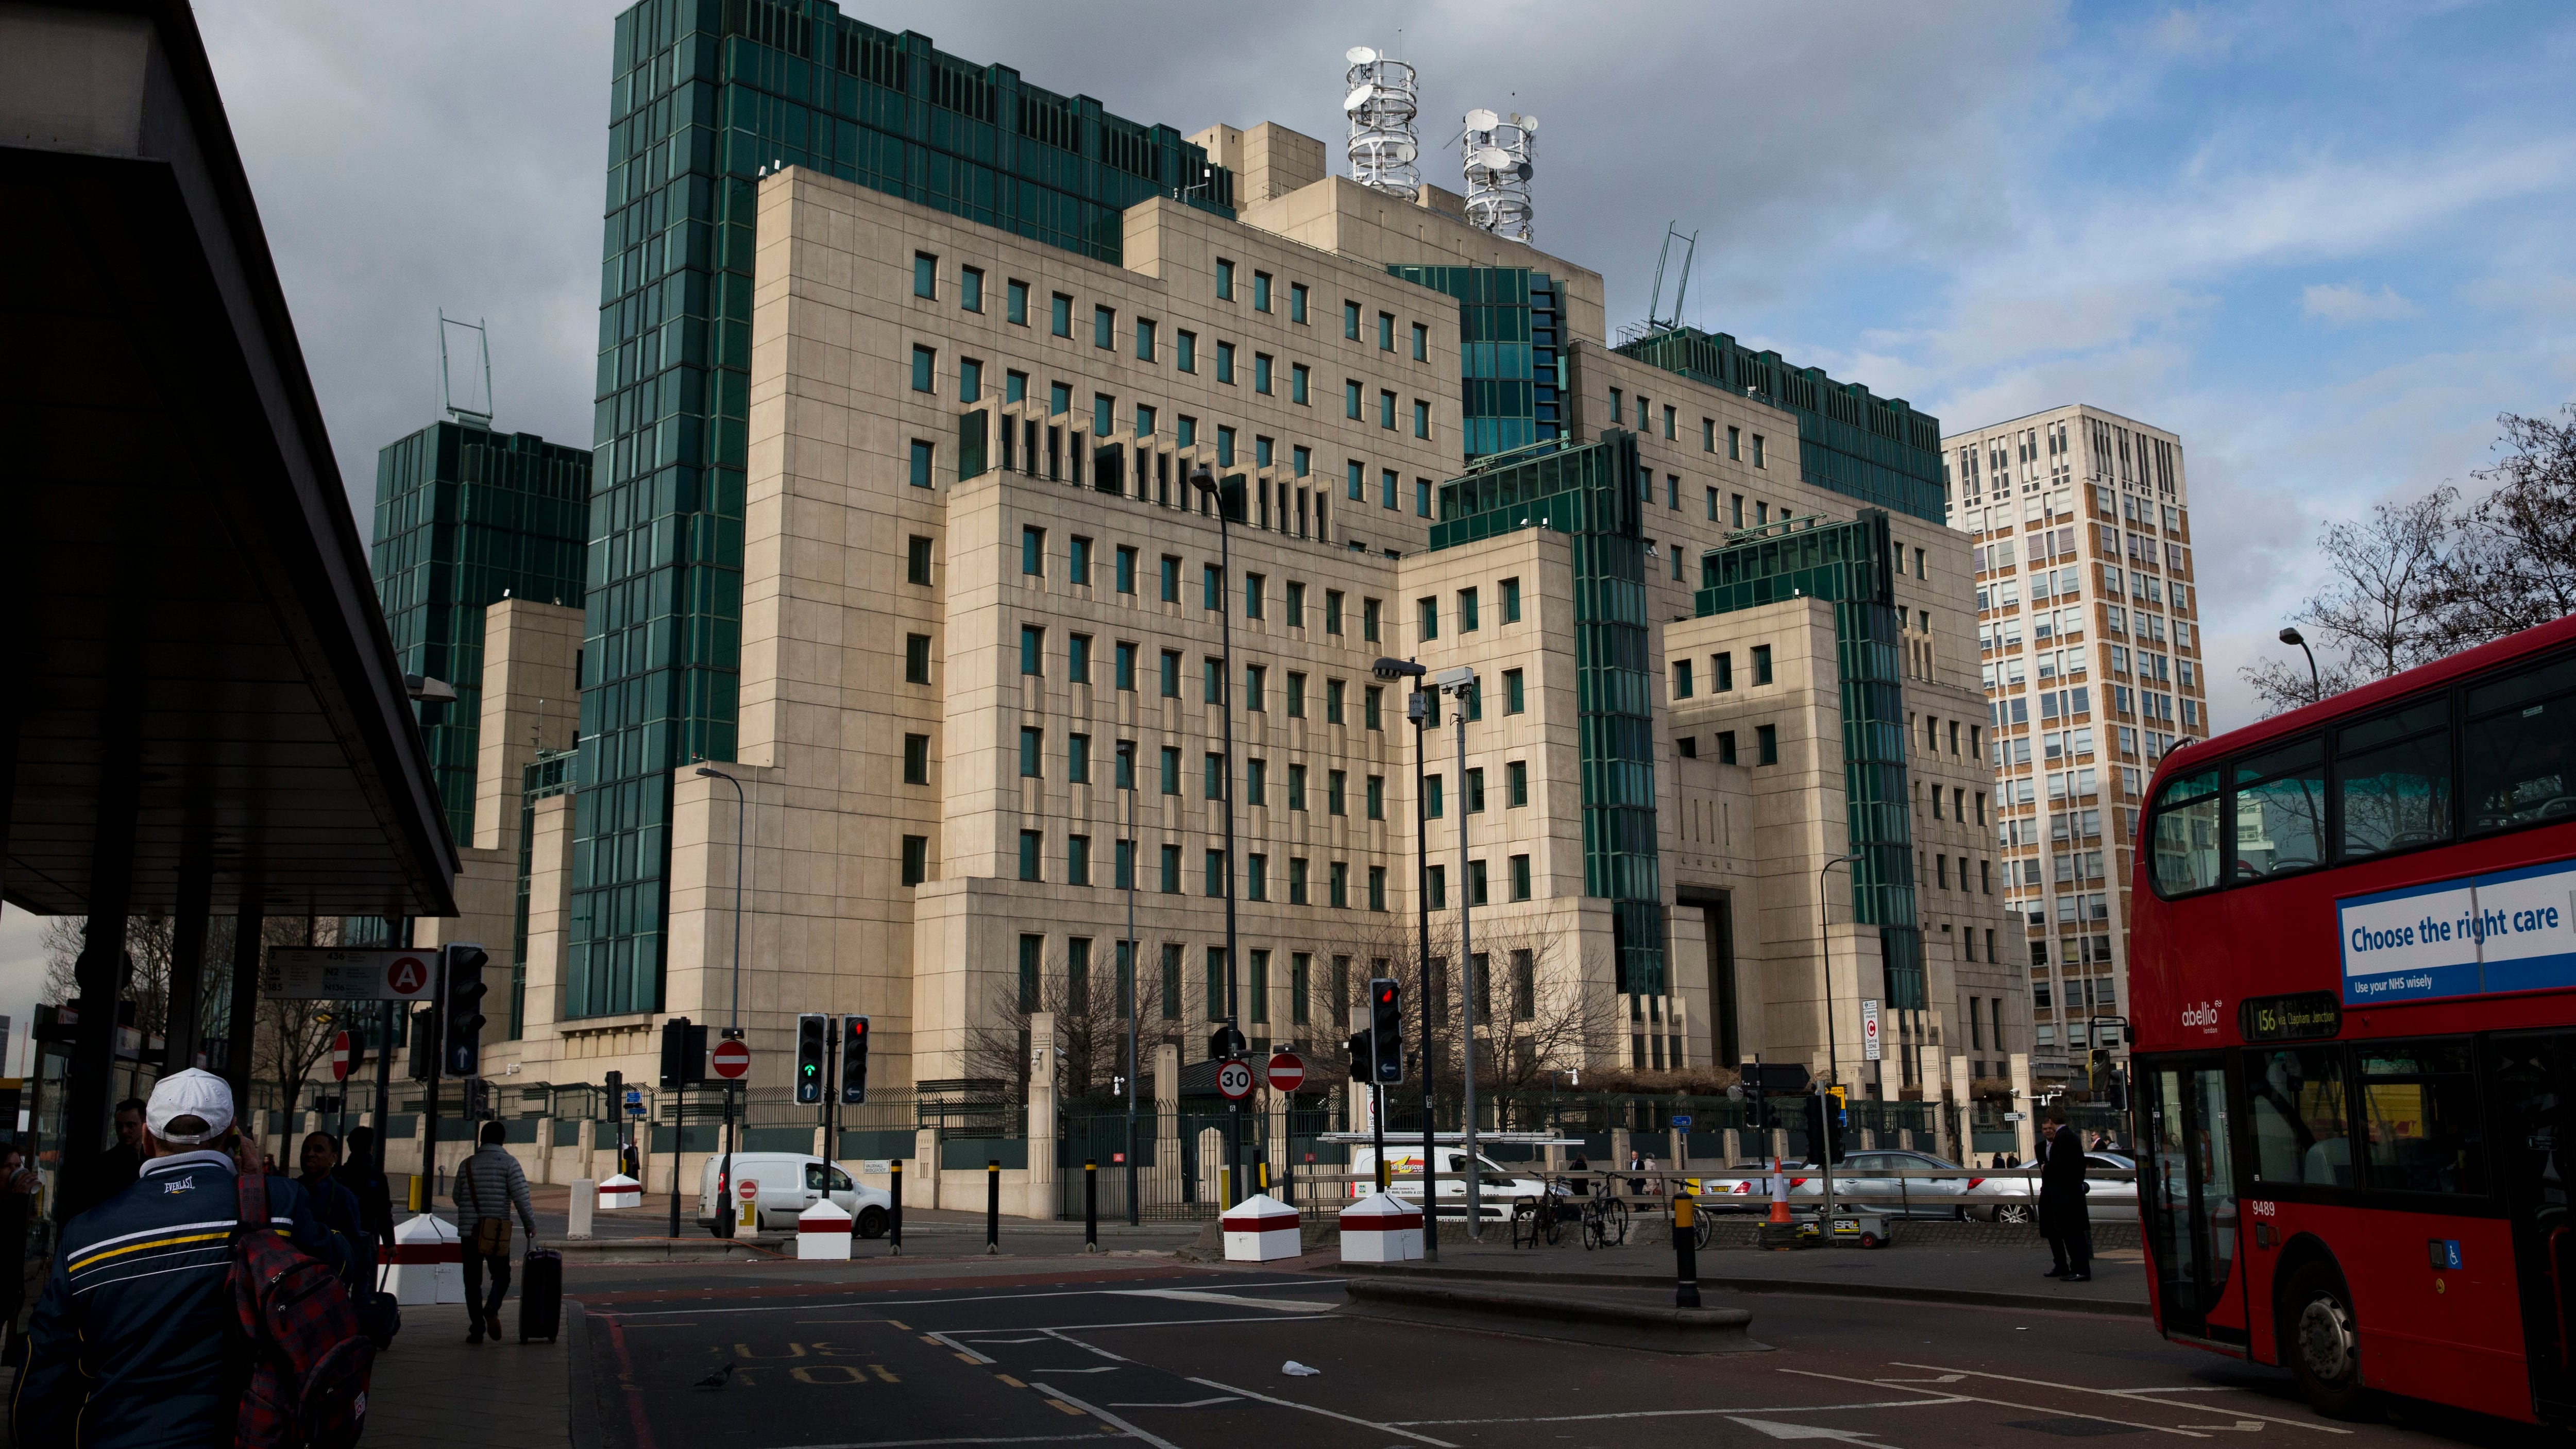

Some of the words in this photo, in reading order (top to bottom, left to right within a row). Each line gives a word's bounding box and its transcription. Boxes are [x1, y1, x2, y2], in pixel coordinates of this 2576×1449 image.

[2352, 926, 2414, 952] Choose
[2419, 916, 2450, 944] the
[2456, 909, 2507, 946] right
[2513, 907, 2558, 933] care
[327, 952, 345, 960] 436
[268, 967, 281, 975] 36
[325, 967, 338, 976] N2
[395, 964, 418, 987] A
[267, 983, 282, 992] 185
[2354, 981, 2368, 993] Use
[2369, 980, 2387, 995] your
[2388, 977, 2405, 990] NHS
[2406, 974, 2432, 990] wisely
[2182, 1001, 2217, 1027] abellio
[2259, 1009, 2276, 1031] 156
[2287, 1012, 2310, 1027] Clapham
[2312, 1011, 2334, 1023] Junction
[1223, 1071, 1248, 1087] 30
[164, 1175, 193, 1194] EVERLAST
[2252, 1200, 2275, 1216] 9489
[1803, 1223, 1819, 1232] RL
[1834, 1220, 1859, 1229] SRL
